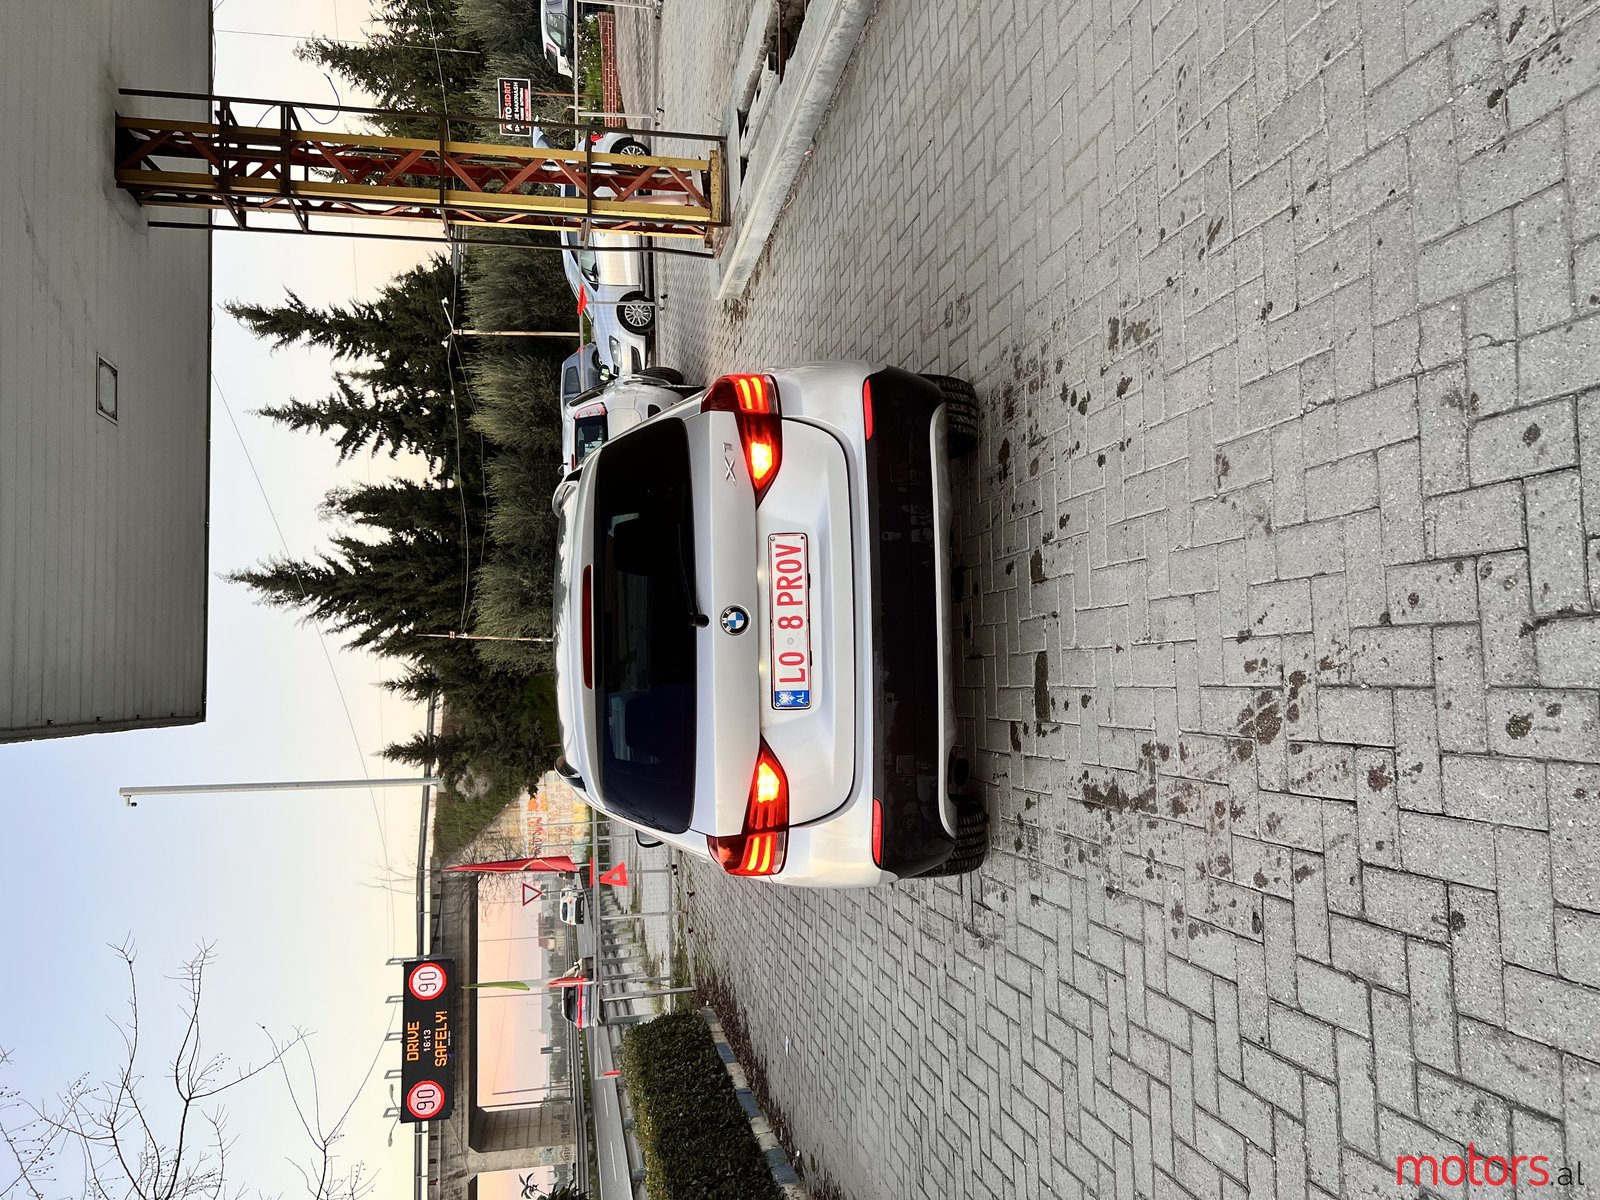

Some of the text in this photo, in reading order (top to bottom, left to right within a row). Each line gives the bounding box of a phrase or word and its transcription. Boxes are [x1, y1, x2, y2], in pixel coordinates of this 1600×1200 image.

[504, 82, 512, 130] ATOSIDRIT
[722, 441, 737, 485] X1
[775, 543, 803, 606] PROV
[777, 615, 804, 630] 8
[796, 691, 805, 704] AL
[418, 971, 437, 992] 90
[406, 1021, 420, 1061] DRIVE
[423, 1029, 432, 1052] 16:13
[434, 1011, 448, 1067] SAFELY!
[416, 1088, 435, 1110] 90
